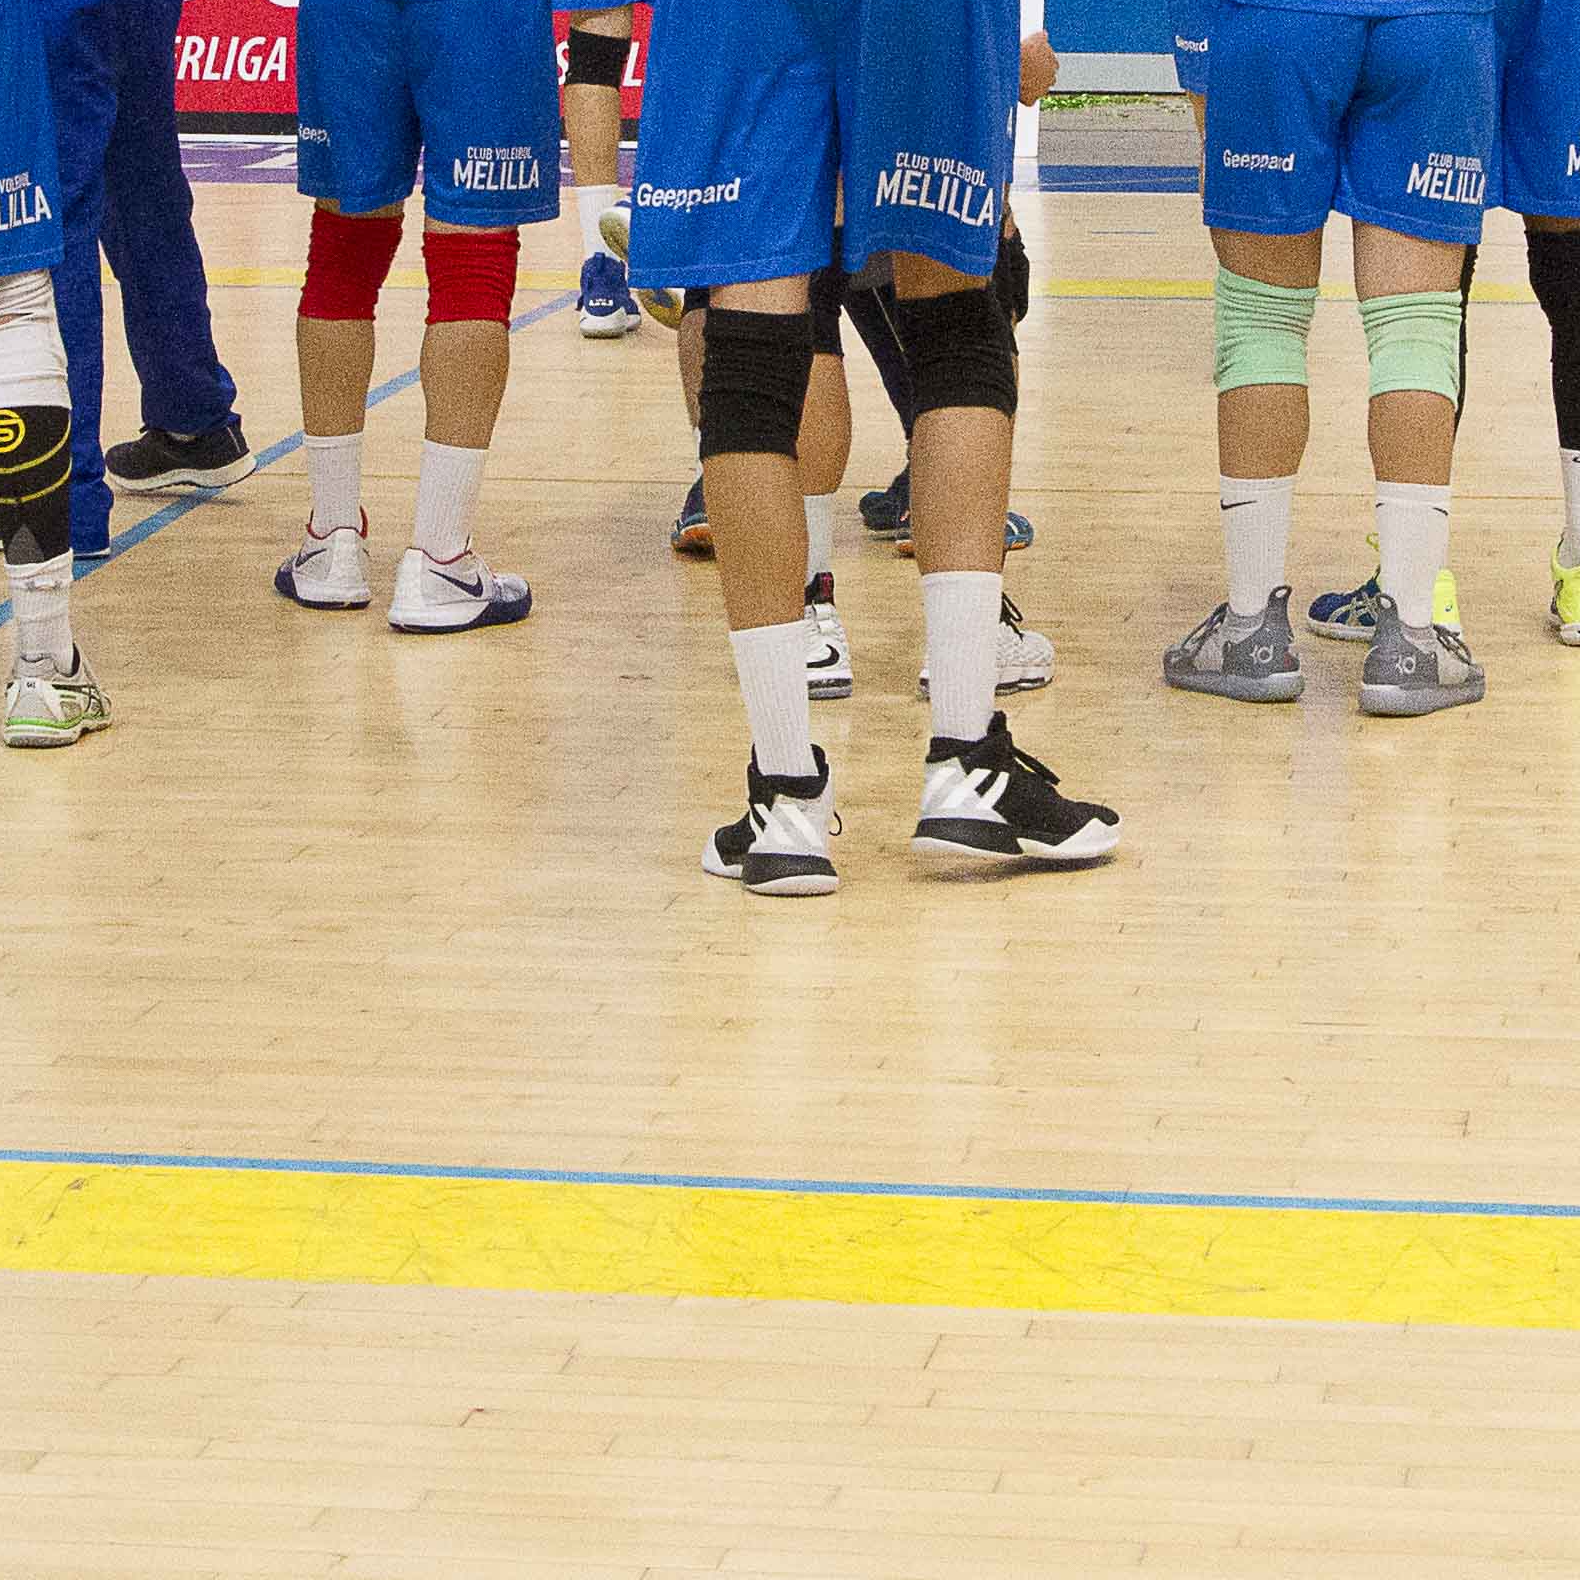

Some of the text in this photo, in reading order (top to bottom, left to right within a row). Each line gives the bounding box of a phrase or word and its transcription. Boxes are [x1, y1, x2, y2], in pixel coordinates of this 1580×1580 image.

[453, 156, 540, 192] MELILLA
[895, 151, 930, 172] CLUB
[635, 177, 740, 213] Geeppard
[875, 169, 997, 228] MELILLA
